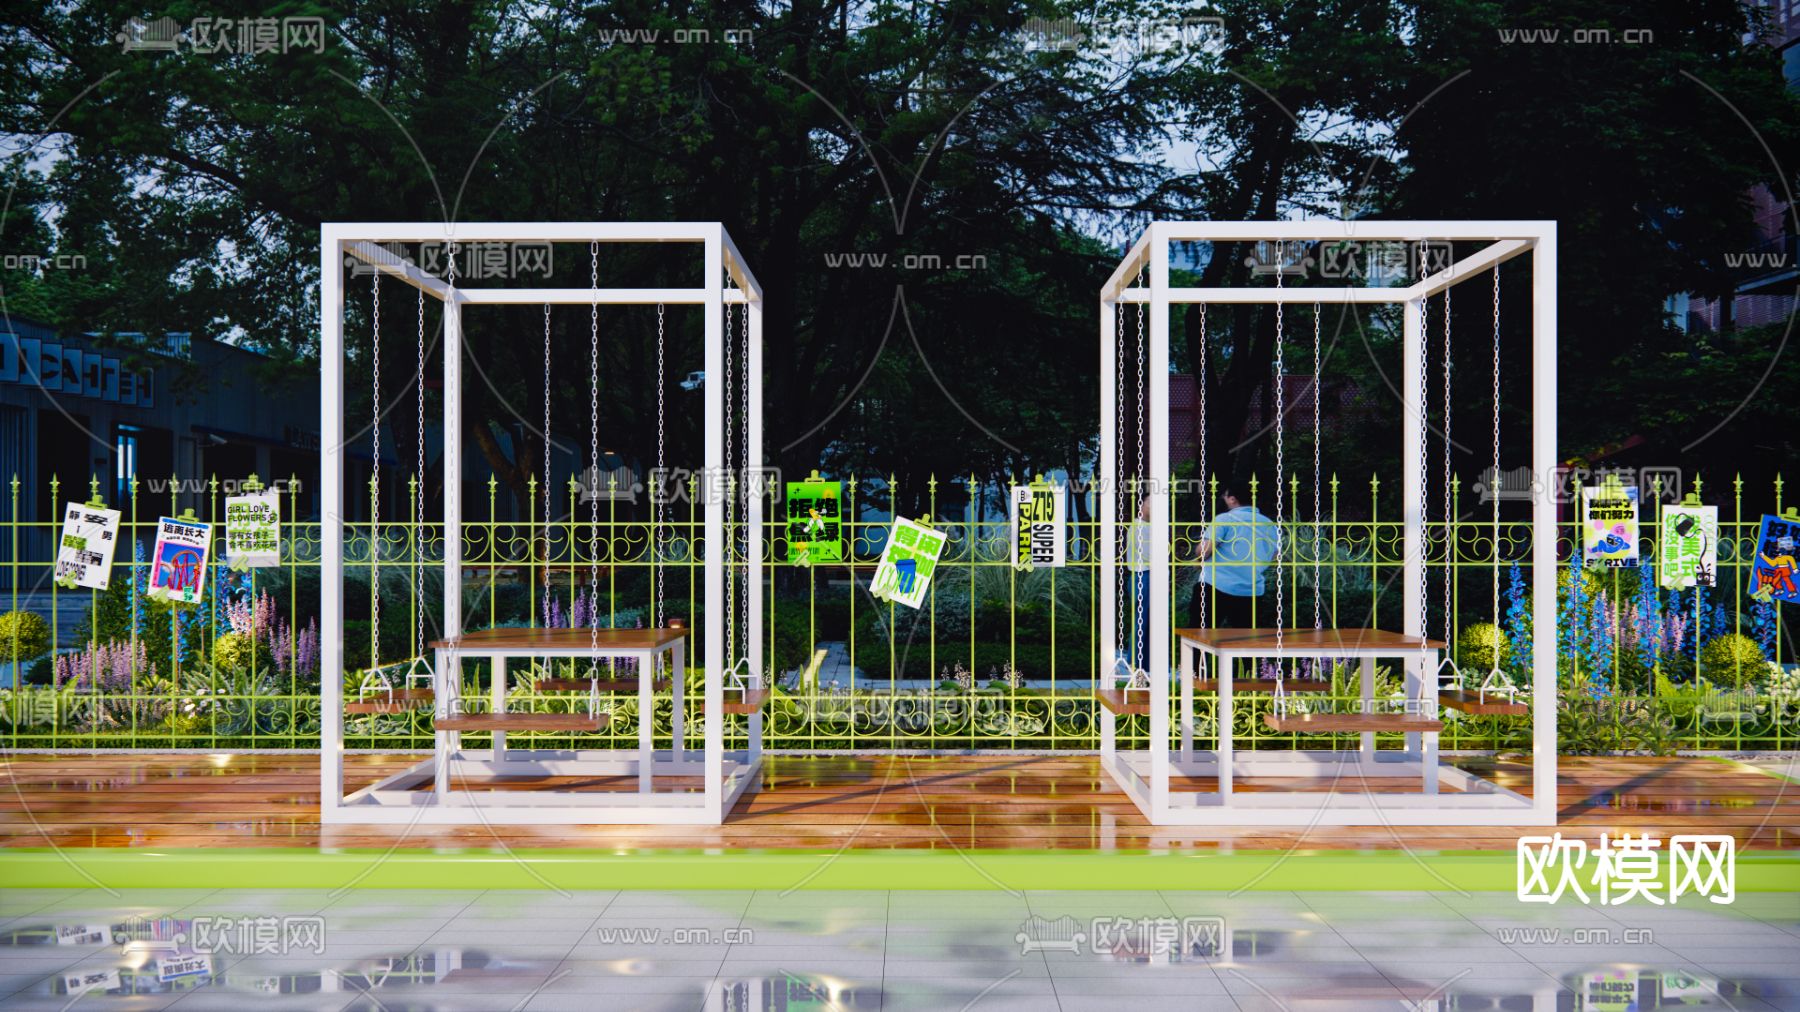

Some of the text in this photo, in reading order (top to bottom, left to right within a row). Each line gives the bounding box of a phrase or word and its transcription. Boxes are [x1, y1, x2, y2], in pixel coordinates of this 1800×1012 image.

[227, 505, 270, 514] GIRL LOVE
[788, 498, 840, 518] 拒绝
[1588, 509, 1635, 520] 你们努力
[227, 514, 267, 522] FLOWERS
[163, 523, 206, 539] 逃离长大
[1018, 503, 1032, 564] PARK
[1032, 523, 1055, 563] SUPER
